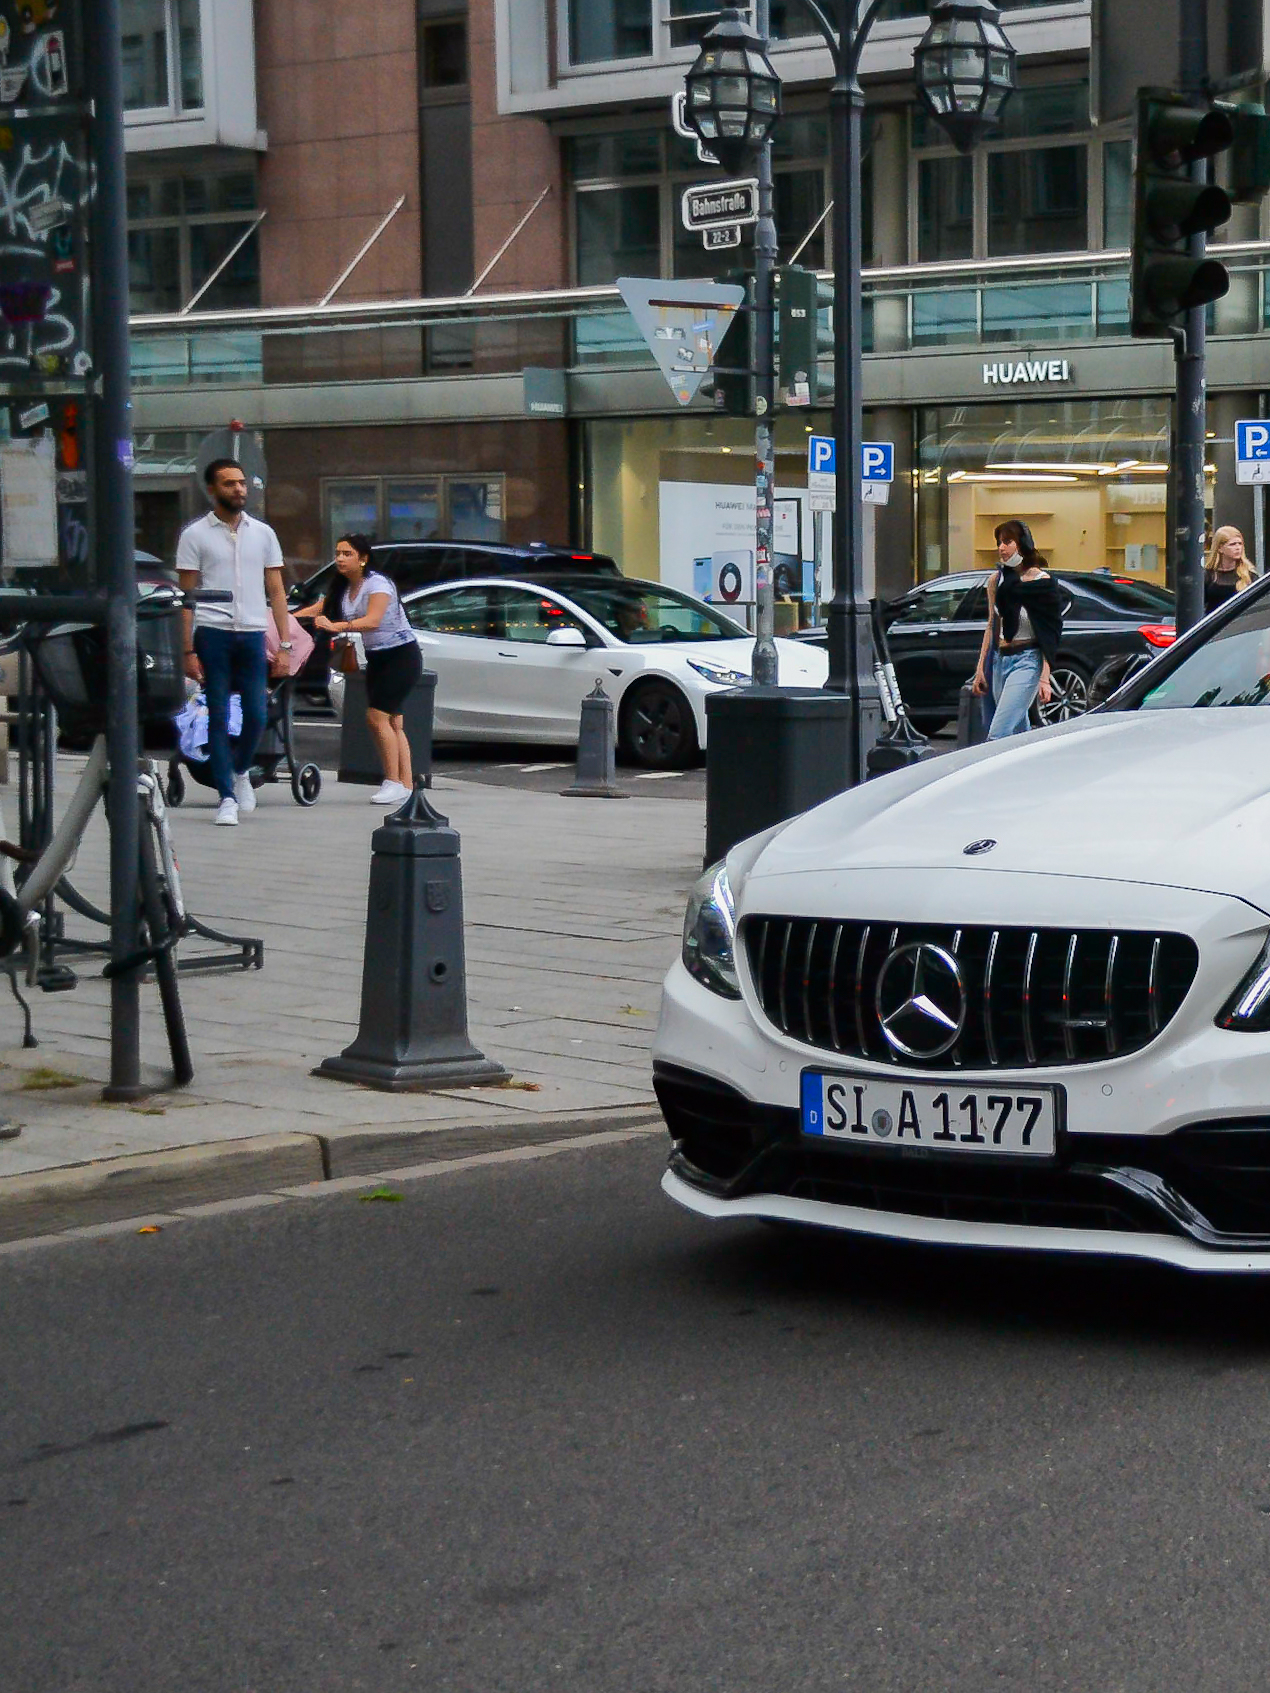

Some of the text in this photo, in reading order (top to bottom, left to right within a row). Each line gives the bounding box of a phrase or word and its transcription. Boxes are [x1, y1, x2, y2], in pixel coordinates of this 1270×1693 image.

[692, 192, 746, 217] Bahnstraße
[982, 360, 1069, 385] HUAWEI
[814, 441, 832, 471] P
[1245, 425, 1269, 459] P
[862, 447, 885, 477] P
[826, 1083, 869, 1135] SI
